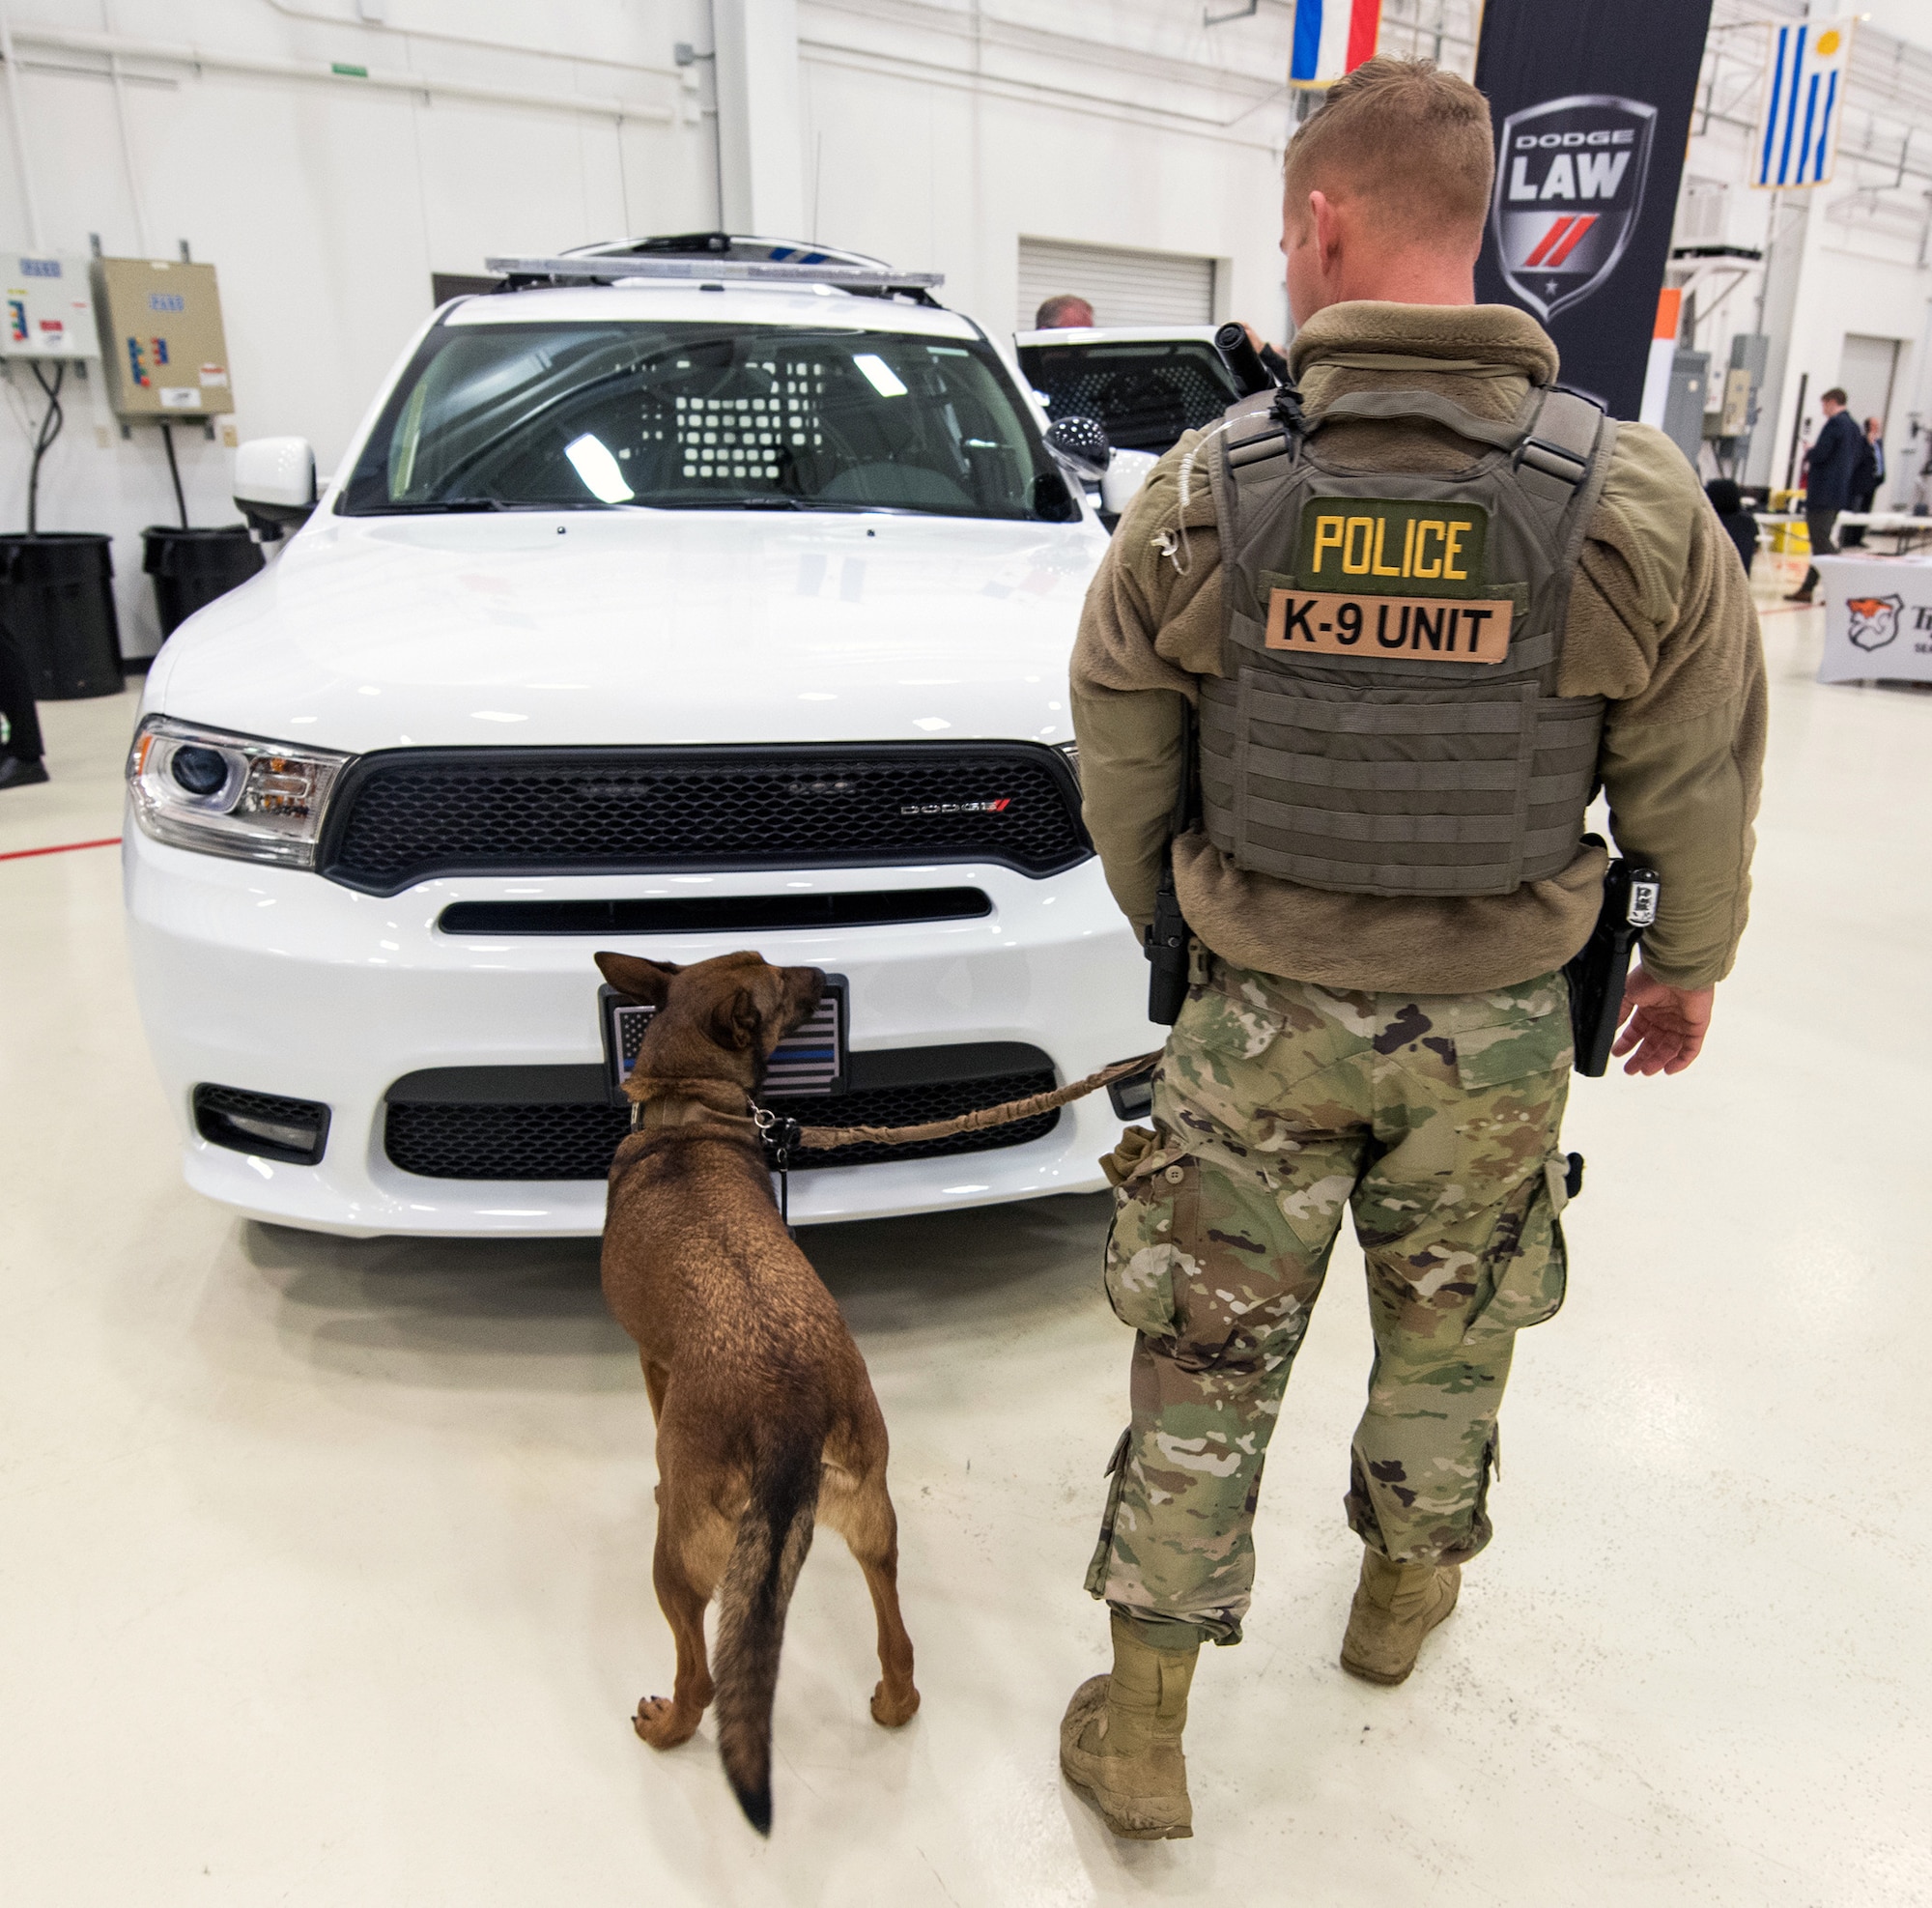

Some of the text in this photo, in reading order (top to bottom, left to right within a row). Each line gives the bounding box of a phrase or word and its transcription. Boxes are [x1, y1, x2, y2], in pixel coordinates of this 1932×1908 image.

[1516, 129, 1635, 149] DODGE
[1508, 151, 1632, 201] LAW
[1312, 515, 1473, 581] POLICE
[1283, 598, 1492, 653] K-9 UNIT
[900, 801, 997, 815] DODGE
